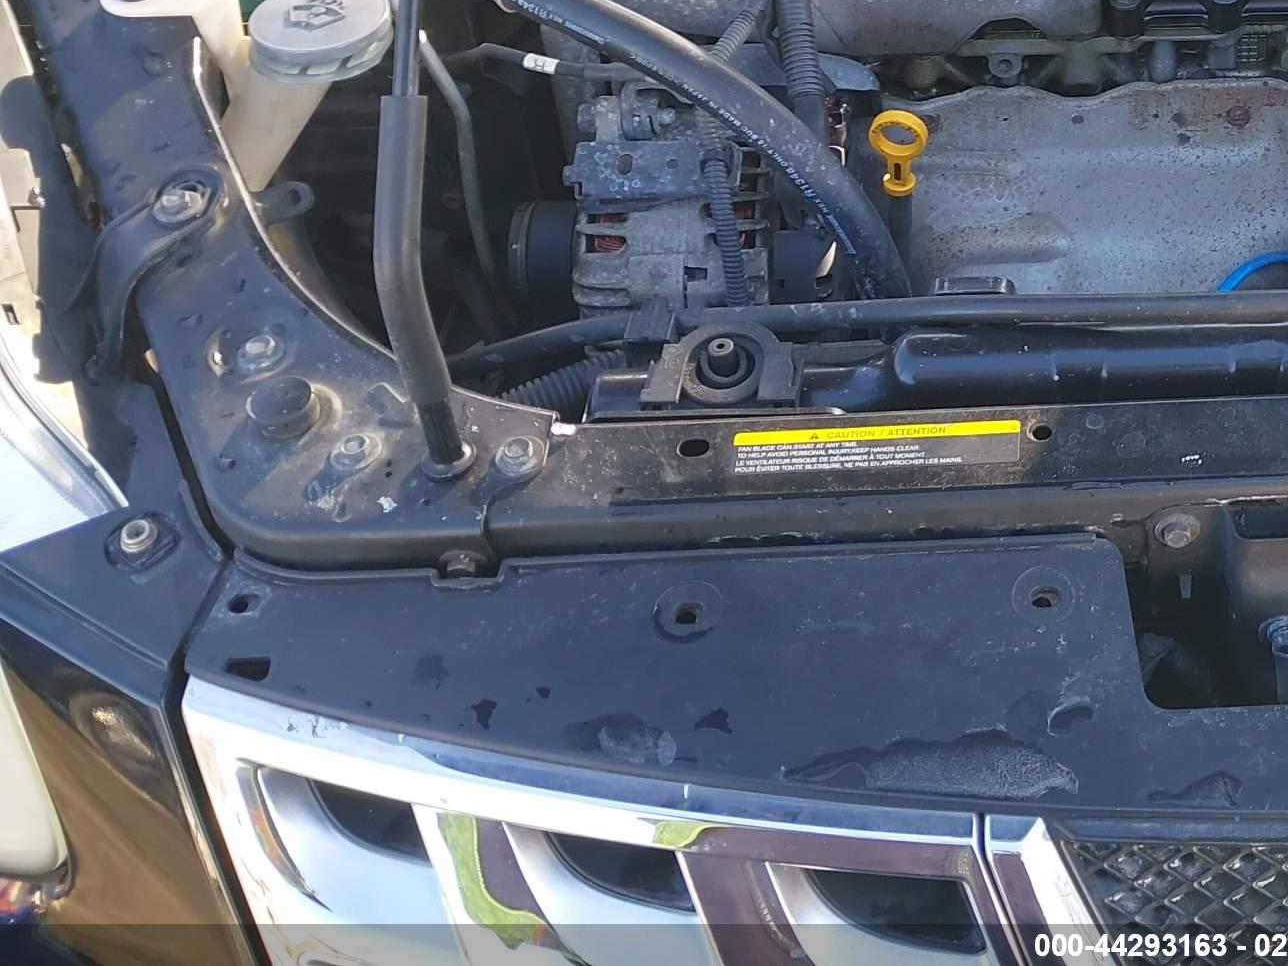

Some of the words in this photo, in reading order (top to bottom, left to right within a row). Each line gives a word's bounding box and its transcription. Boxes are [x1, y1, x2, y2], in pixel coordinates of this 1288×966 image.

[682, 83, 709, 102] JAPAN
[707, 100, 719, 110] IN
[718, 107, 741, 127] MADE
[766, 149, 788, 167] ONLY
[827, 430, 874, 439] CAUTION
[888, 427, 946, 436] ATTENTION
[746, 458, 790, 466] VENTILATEUR
[830, 454, 868, 462] DÉMARRER
[880, 458, 924, 466] APPROCHER
